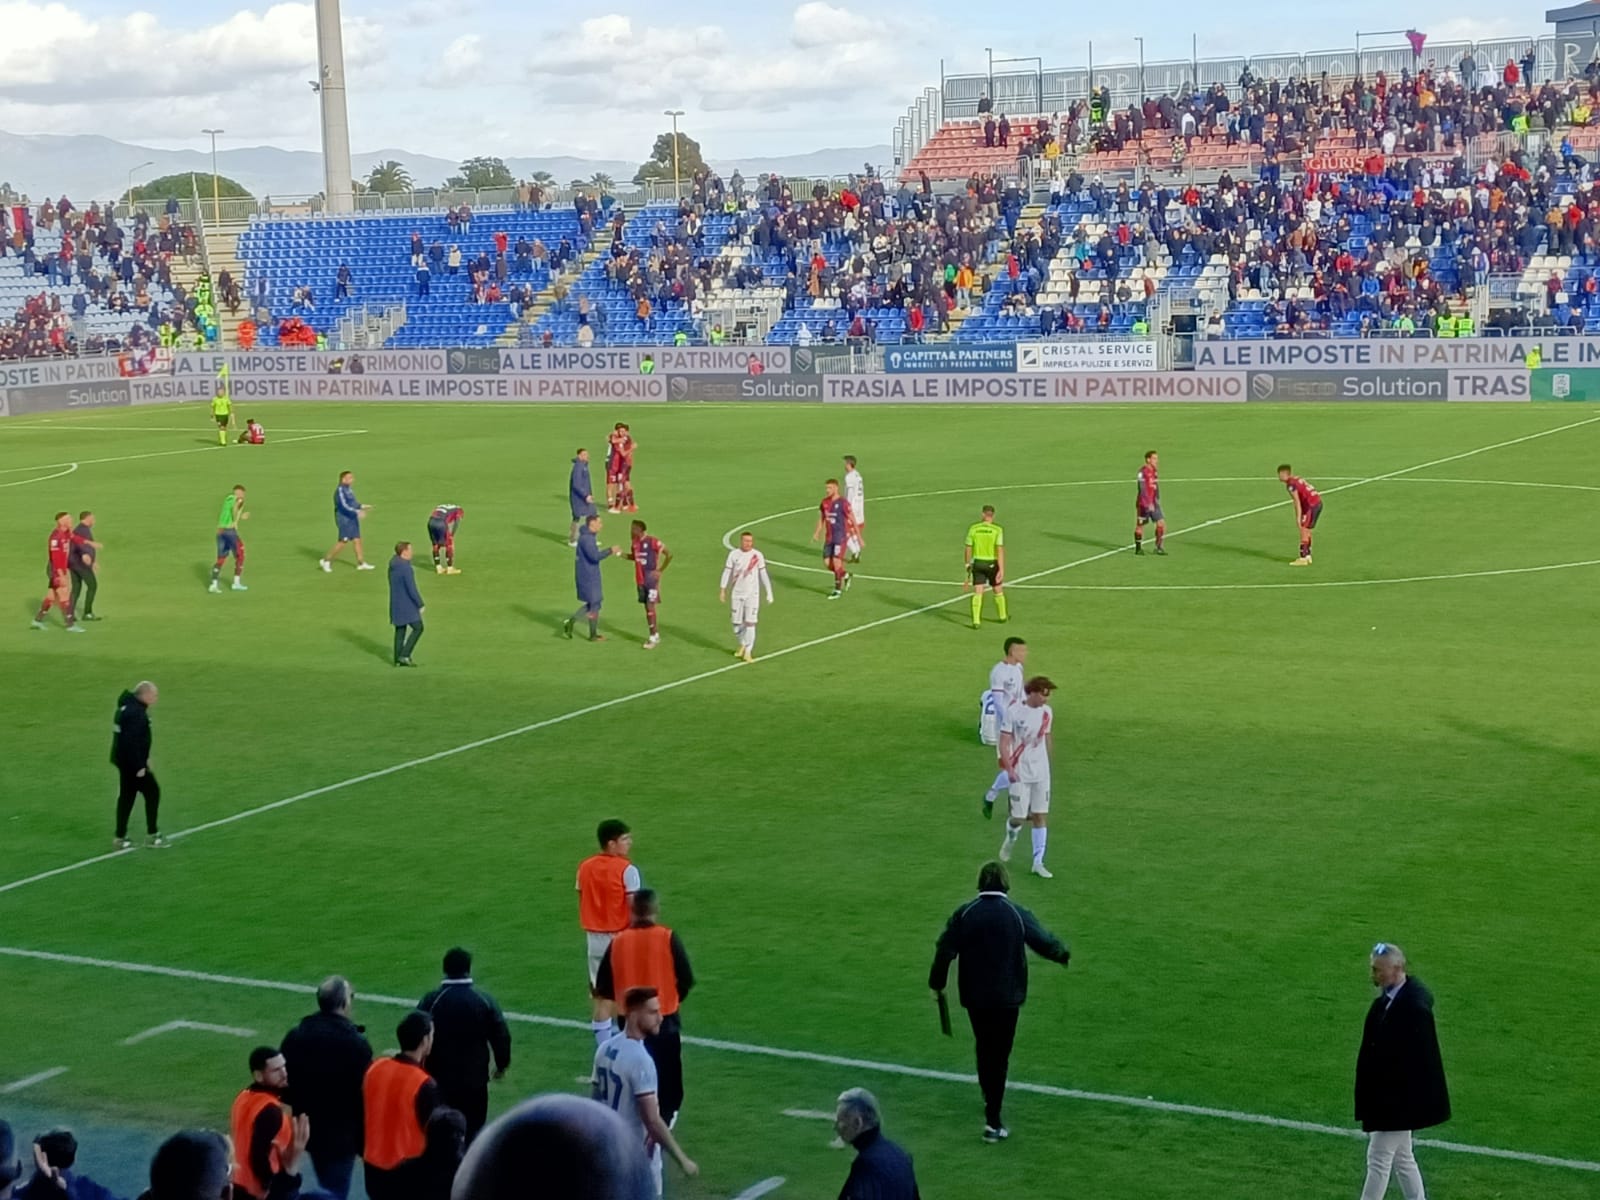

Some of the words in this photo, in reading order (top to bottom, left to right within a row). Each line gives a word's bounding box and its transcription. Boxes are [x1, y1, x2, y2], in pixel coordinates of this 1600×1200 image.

[959, 350, 1013, 360] PARTNERS
[1042, 345, 1093, 355] CRISTAL
[1098, 344, 1153, 354] SERVICE
[1223, 346, 1251, 364] LE
[1260, 345, 1371, 364] IMPOSTE
[1380, 344, 1403, 363] IN
[1540, 343, 1569, 363] LE
[200, 357, 225, 372] LE
[231, 356, 307, 372] IMPOSTE
[311, 356, 328, 371] IN
[502, 354, 515, 370] A
[520, 354, 542, 370] LE
[547, 352, 630, 369] IMPOSTE
[1043, 360, 1079, 368] IMPRESA
[1081, 360, 1110, 368] PULIZIE
[1114, 360, 1119, 368] E
[1121, 360, 1153, 368] SERVIZI
[44, 365, 61, 382] IN
[133, 381, 187, 399] TRASIA
[191, 380, 209, 396] LE
[295, 380, 312, 396] IN
[400, 380, 420, 396] LE
[426, 380, 508, 396] IMPOSTE
[514, 380, 532, 396] IN
[539, 379, 663, 397] PATRIMONIO
[742, 379, 819, 397] Solution
[828, 379, 904, 398] TRASIA
[912, 379, 938, 398] LE
[945, 378, 1047, 398] IMPOSTE
[1055, 377, 1077, 397] IN
[1087, 376, 1241, 397] PATRIMONIO
[1343, 375, 1442, 396] Solution
[1454, 375, 1527, 396] TRAS
[67, 388, 127, 406] Solution
